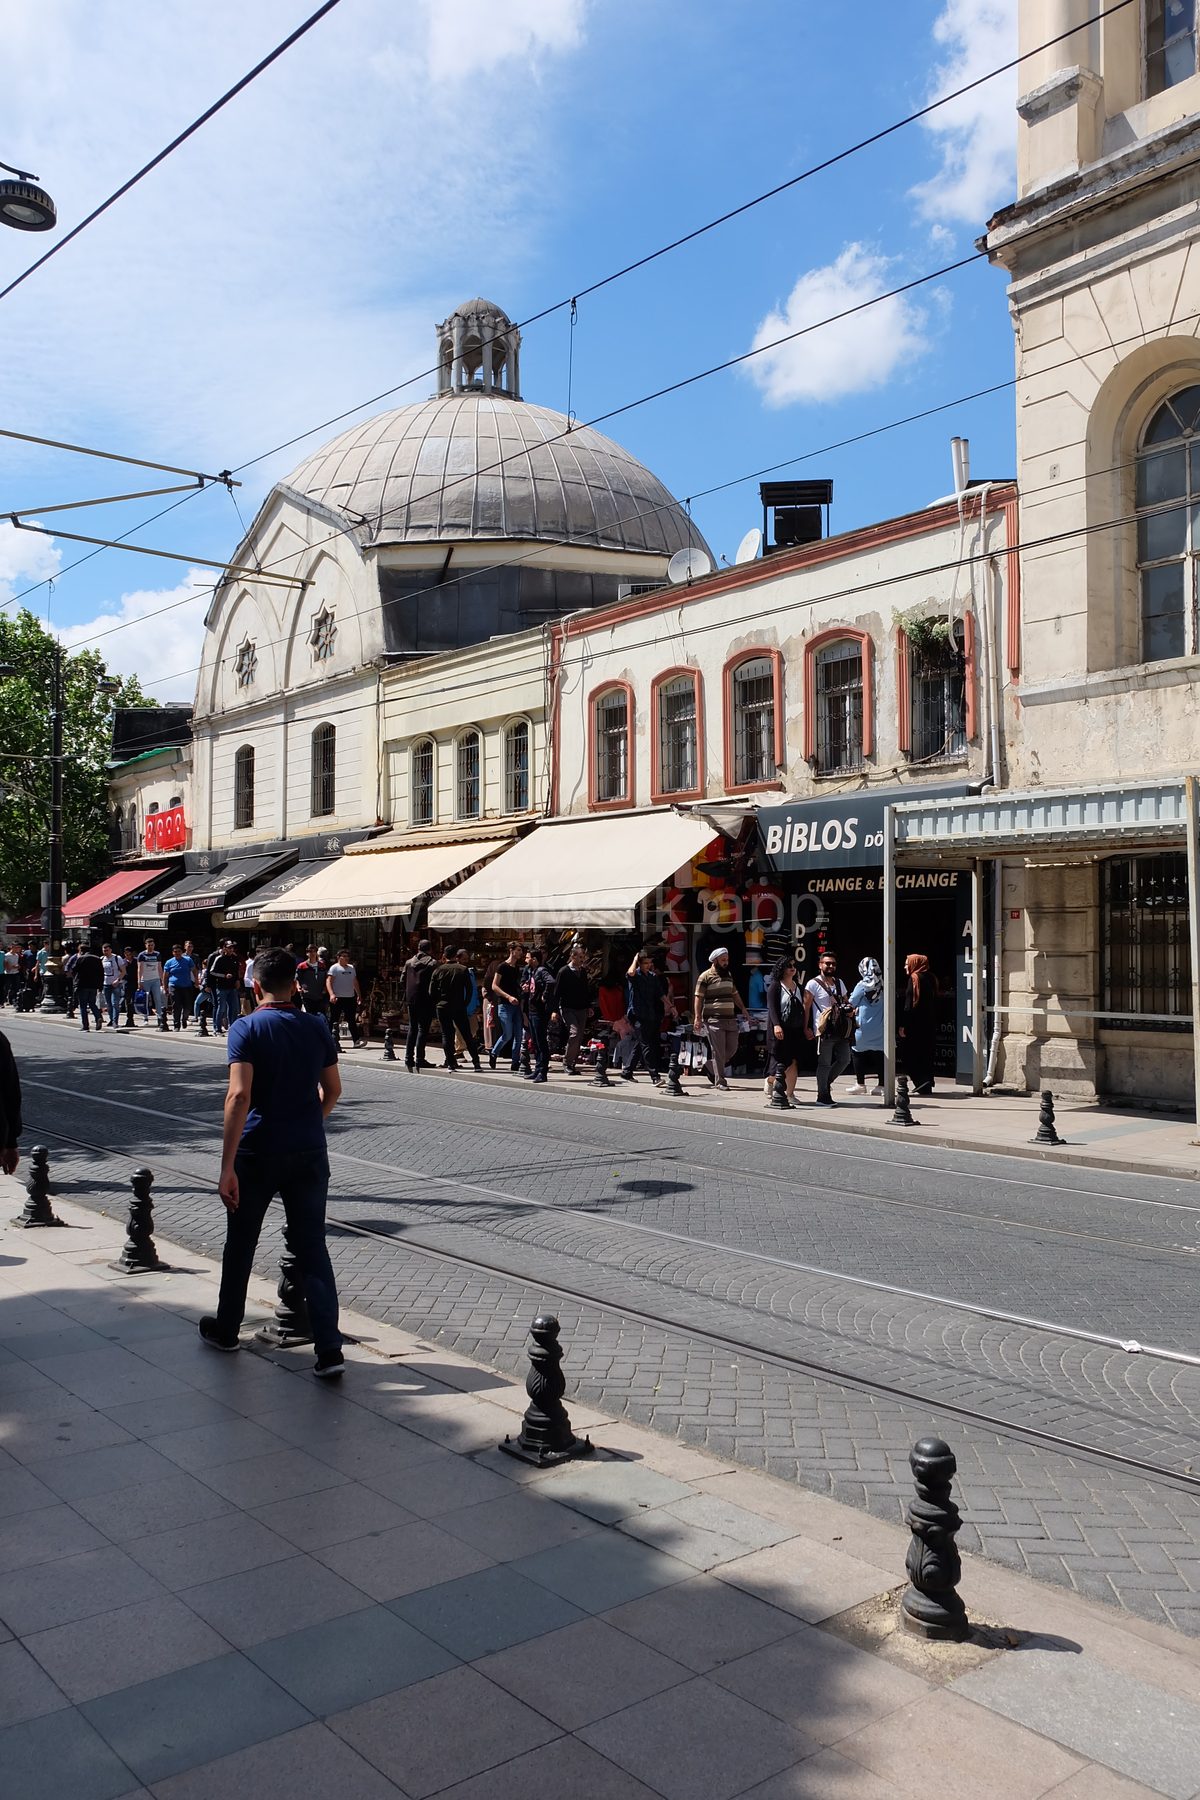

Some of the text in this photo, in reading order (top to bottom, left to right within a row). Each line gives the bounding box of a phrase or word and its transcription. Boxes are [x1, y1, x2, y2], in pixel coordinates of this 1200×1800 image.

[765, 816, 859, 855] BİBLOS
[807, 872, 959, 893] CHANGE & ECHANGE
